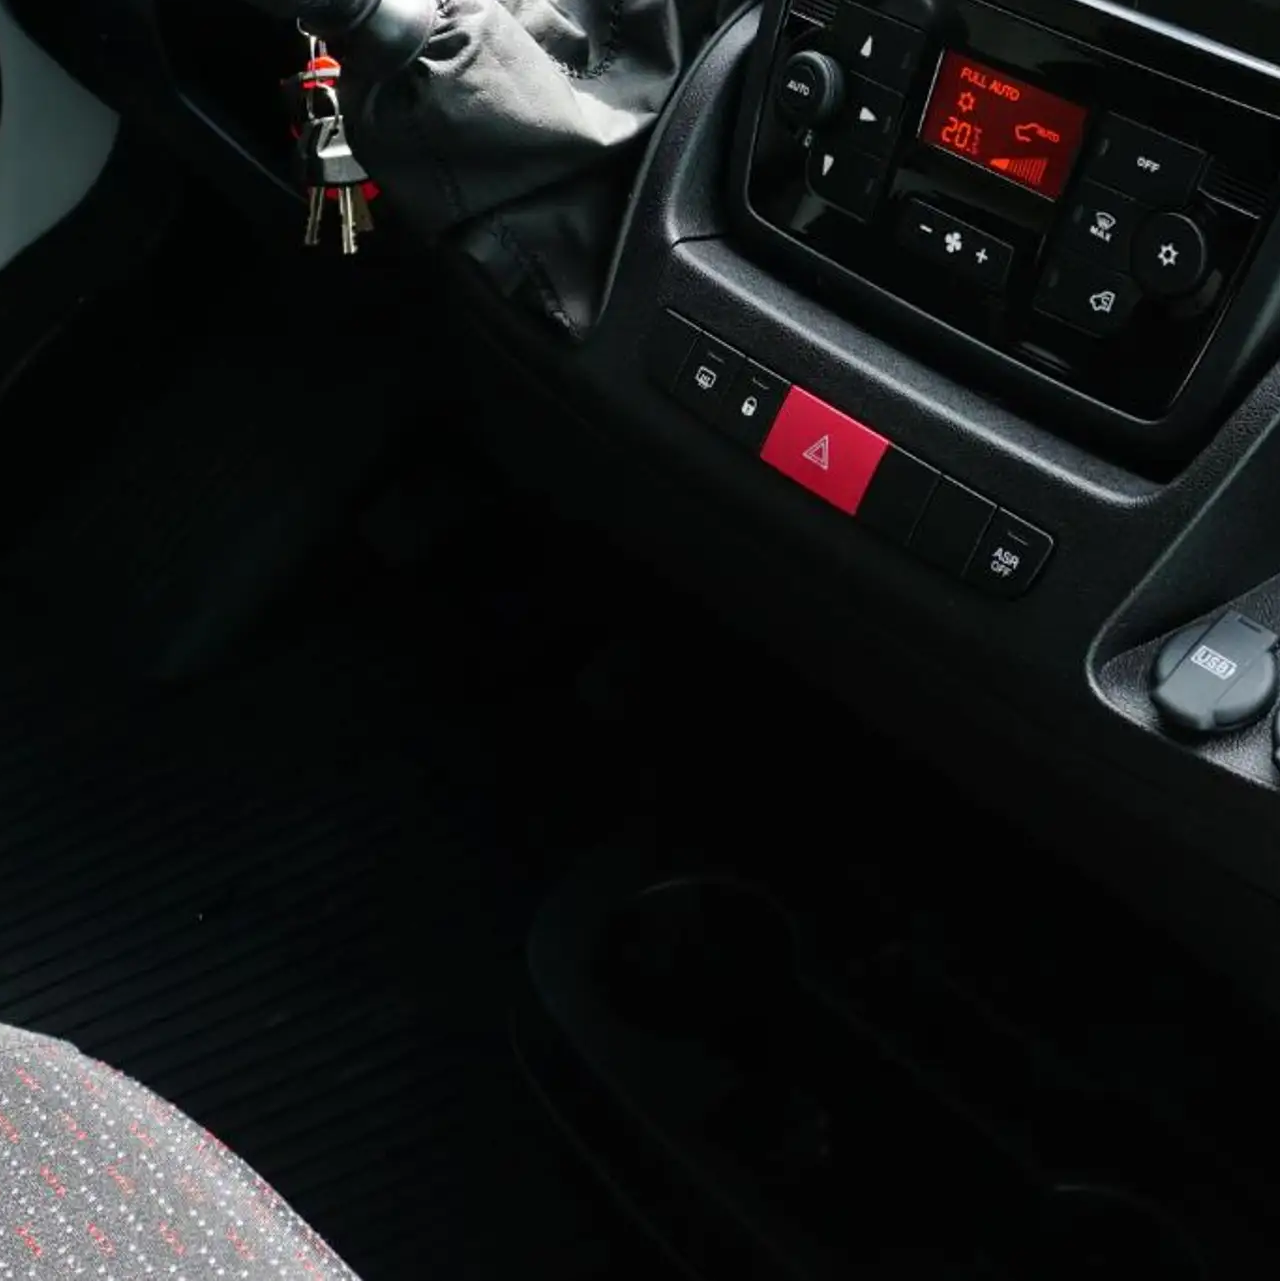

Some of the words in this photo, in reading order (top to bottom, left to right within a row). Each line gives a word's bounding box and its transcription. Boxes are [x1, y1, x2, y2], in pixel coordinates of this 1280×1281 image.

[786, 79, 810, 97] AUTO
[960, 66, 986, 88] FULL
[988, 79, 1021, 102] AUTO
[1136, 156, 1161, 173] OFF
[1089, 225, 1112, 242] MAX
[991, 547, 1020, 570] ASR
[990, 560, 1013, 577] OFF
[1196, 650, 1229, 674] USB
